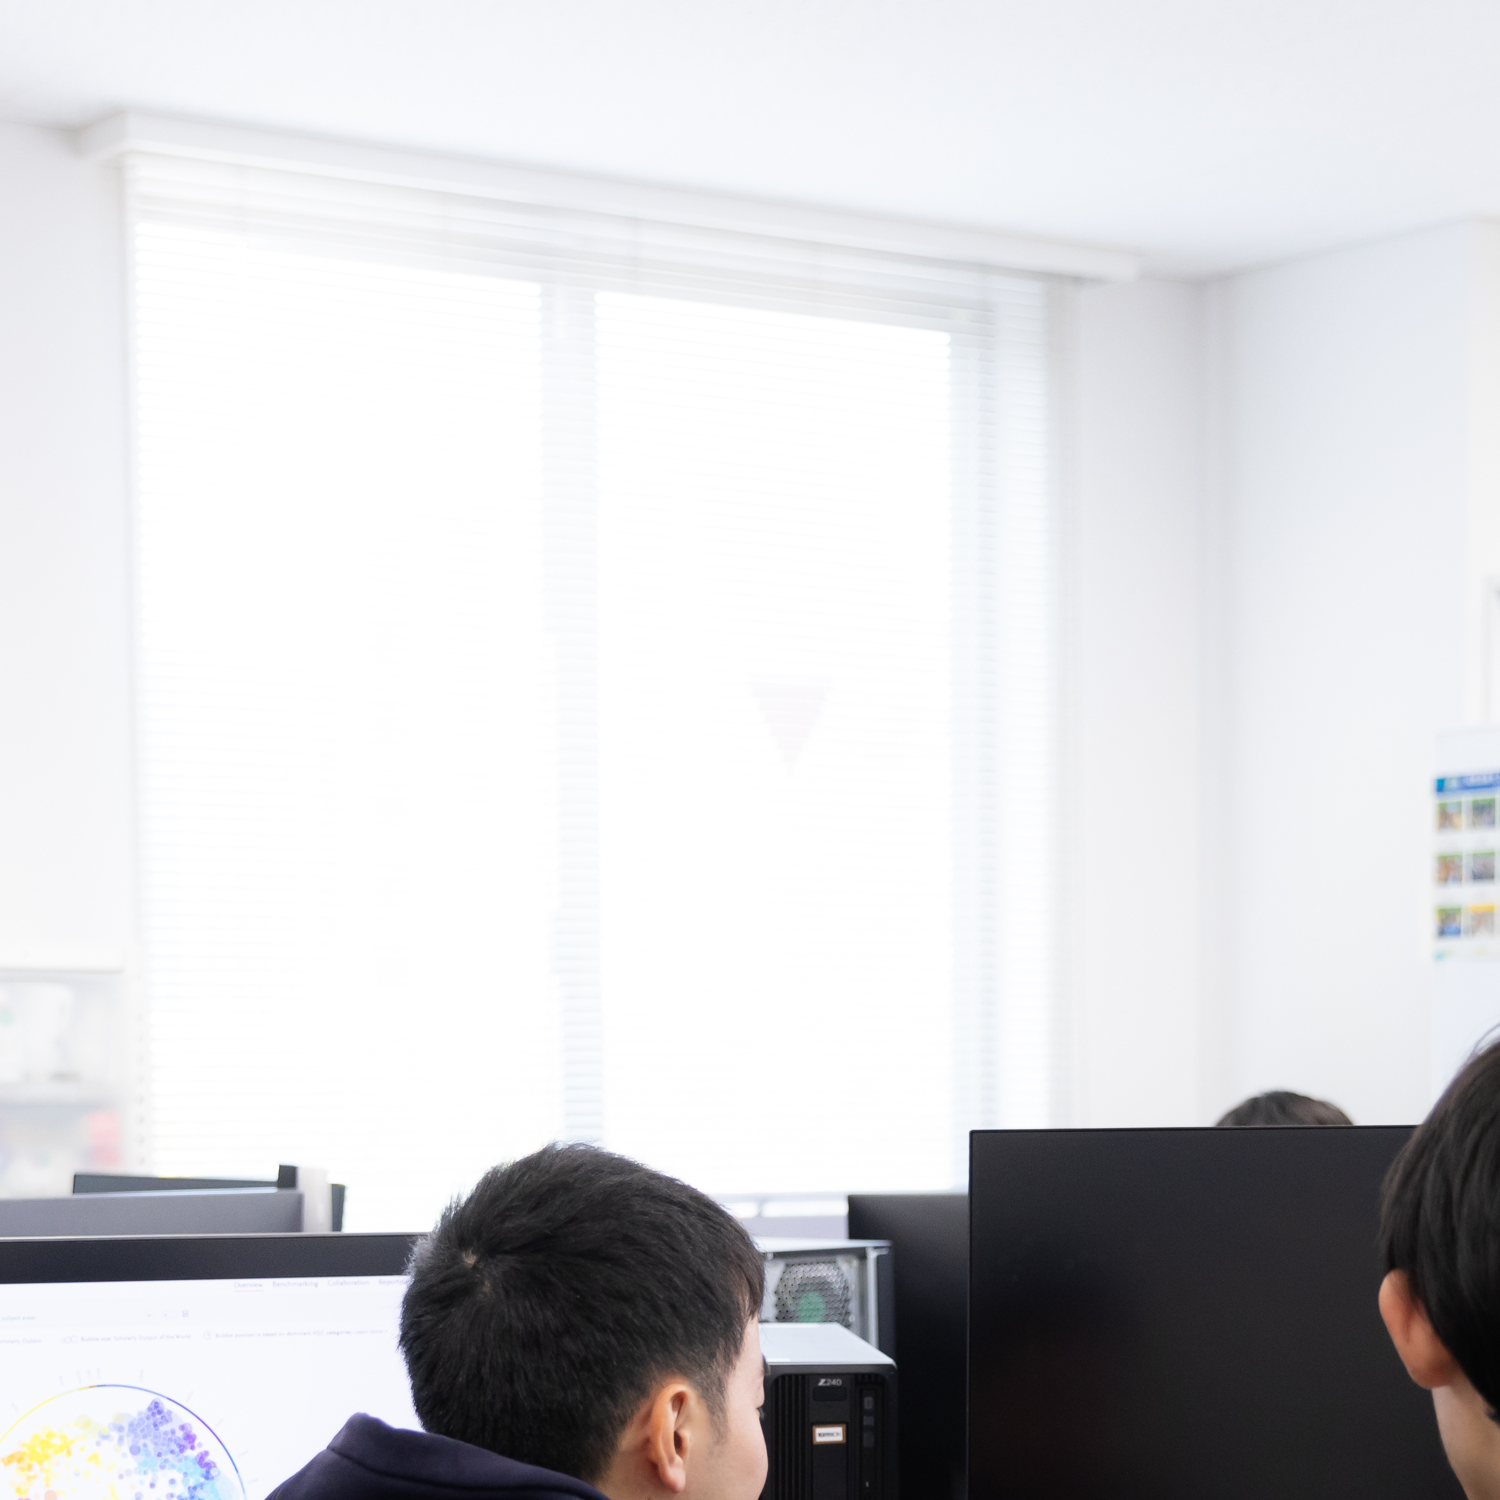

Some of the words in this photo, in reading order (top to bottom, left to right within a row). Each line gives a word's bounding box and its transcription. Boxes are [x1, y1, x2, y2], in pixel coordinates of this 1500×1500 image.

[234, 1281, 264, 1289] Overview
[272, 1280, 319, 1289] Benchmarking
[327, 1279, 370, 1287] Collaboration
[817, 1377, 843, 1387] Z240
